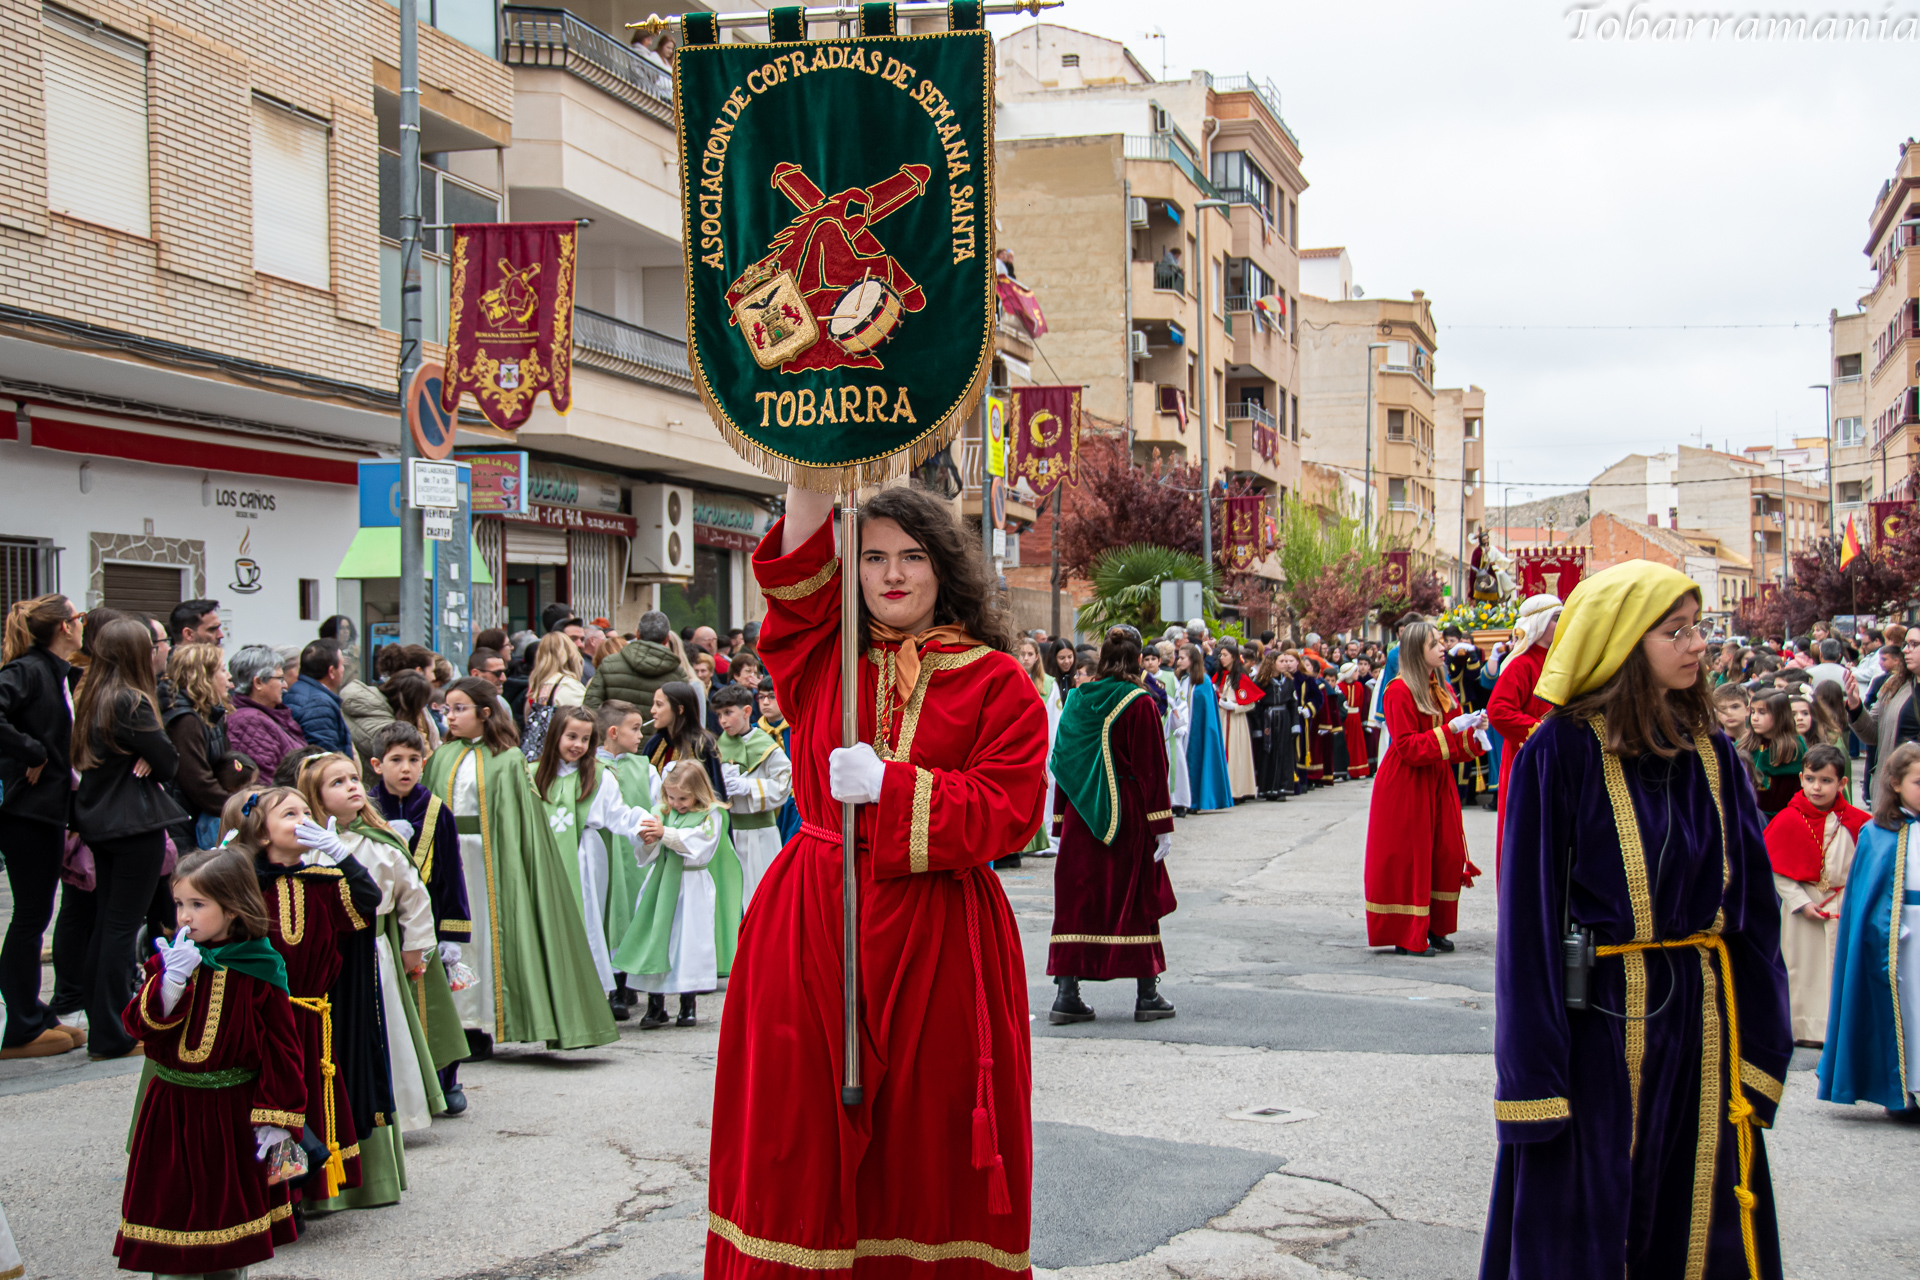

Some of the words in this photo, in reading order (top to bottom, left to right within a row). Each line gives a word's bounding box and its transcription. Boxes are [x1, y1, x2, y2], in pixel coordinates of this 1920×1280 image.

[699, 118, 735, 271] ASOCIACION
[722, 86, 752, 121] DE
[746, 46, 882, 95] COFRADIAS
[881, 56, 917, 90] DE
[909, 79, 971, 180] SEMANA
[949, 183, 976, 265] SANTA
[755, 385, 918, 428] TOBARRA
[428, 467, 455, 476] LABORABLES
[492, 458, 501, 467] LA
[503, 461, 519, 474] PAZ
[417, 484, 440, 494] EXCEPTO
[440, 486, 455, 494] CARGA
[216, 488, 238, 507] LOS
[239, 489, 276, 511] CAÑOS
[426, 494, 451, 503] DESCARGA
